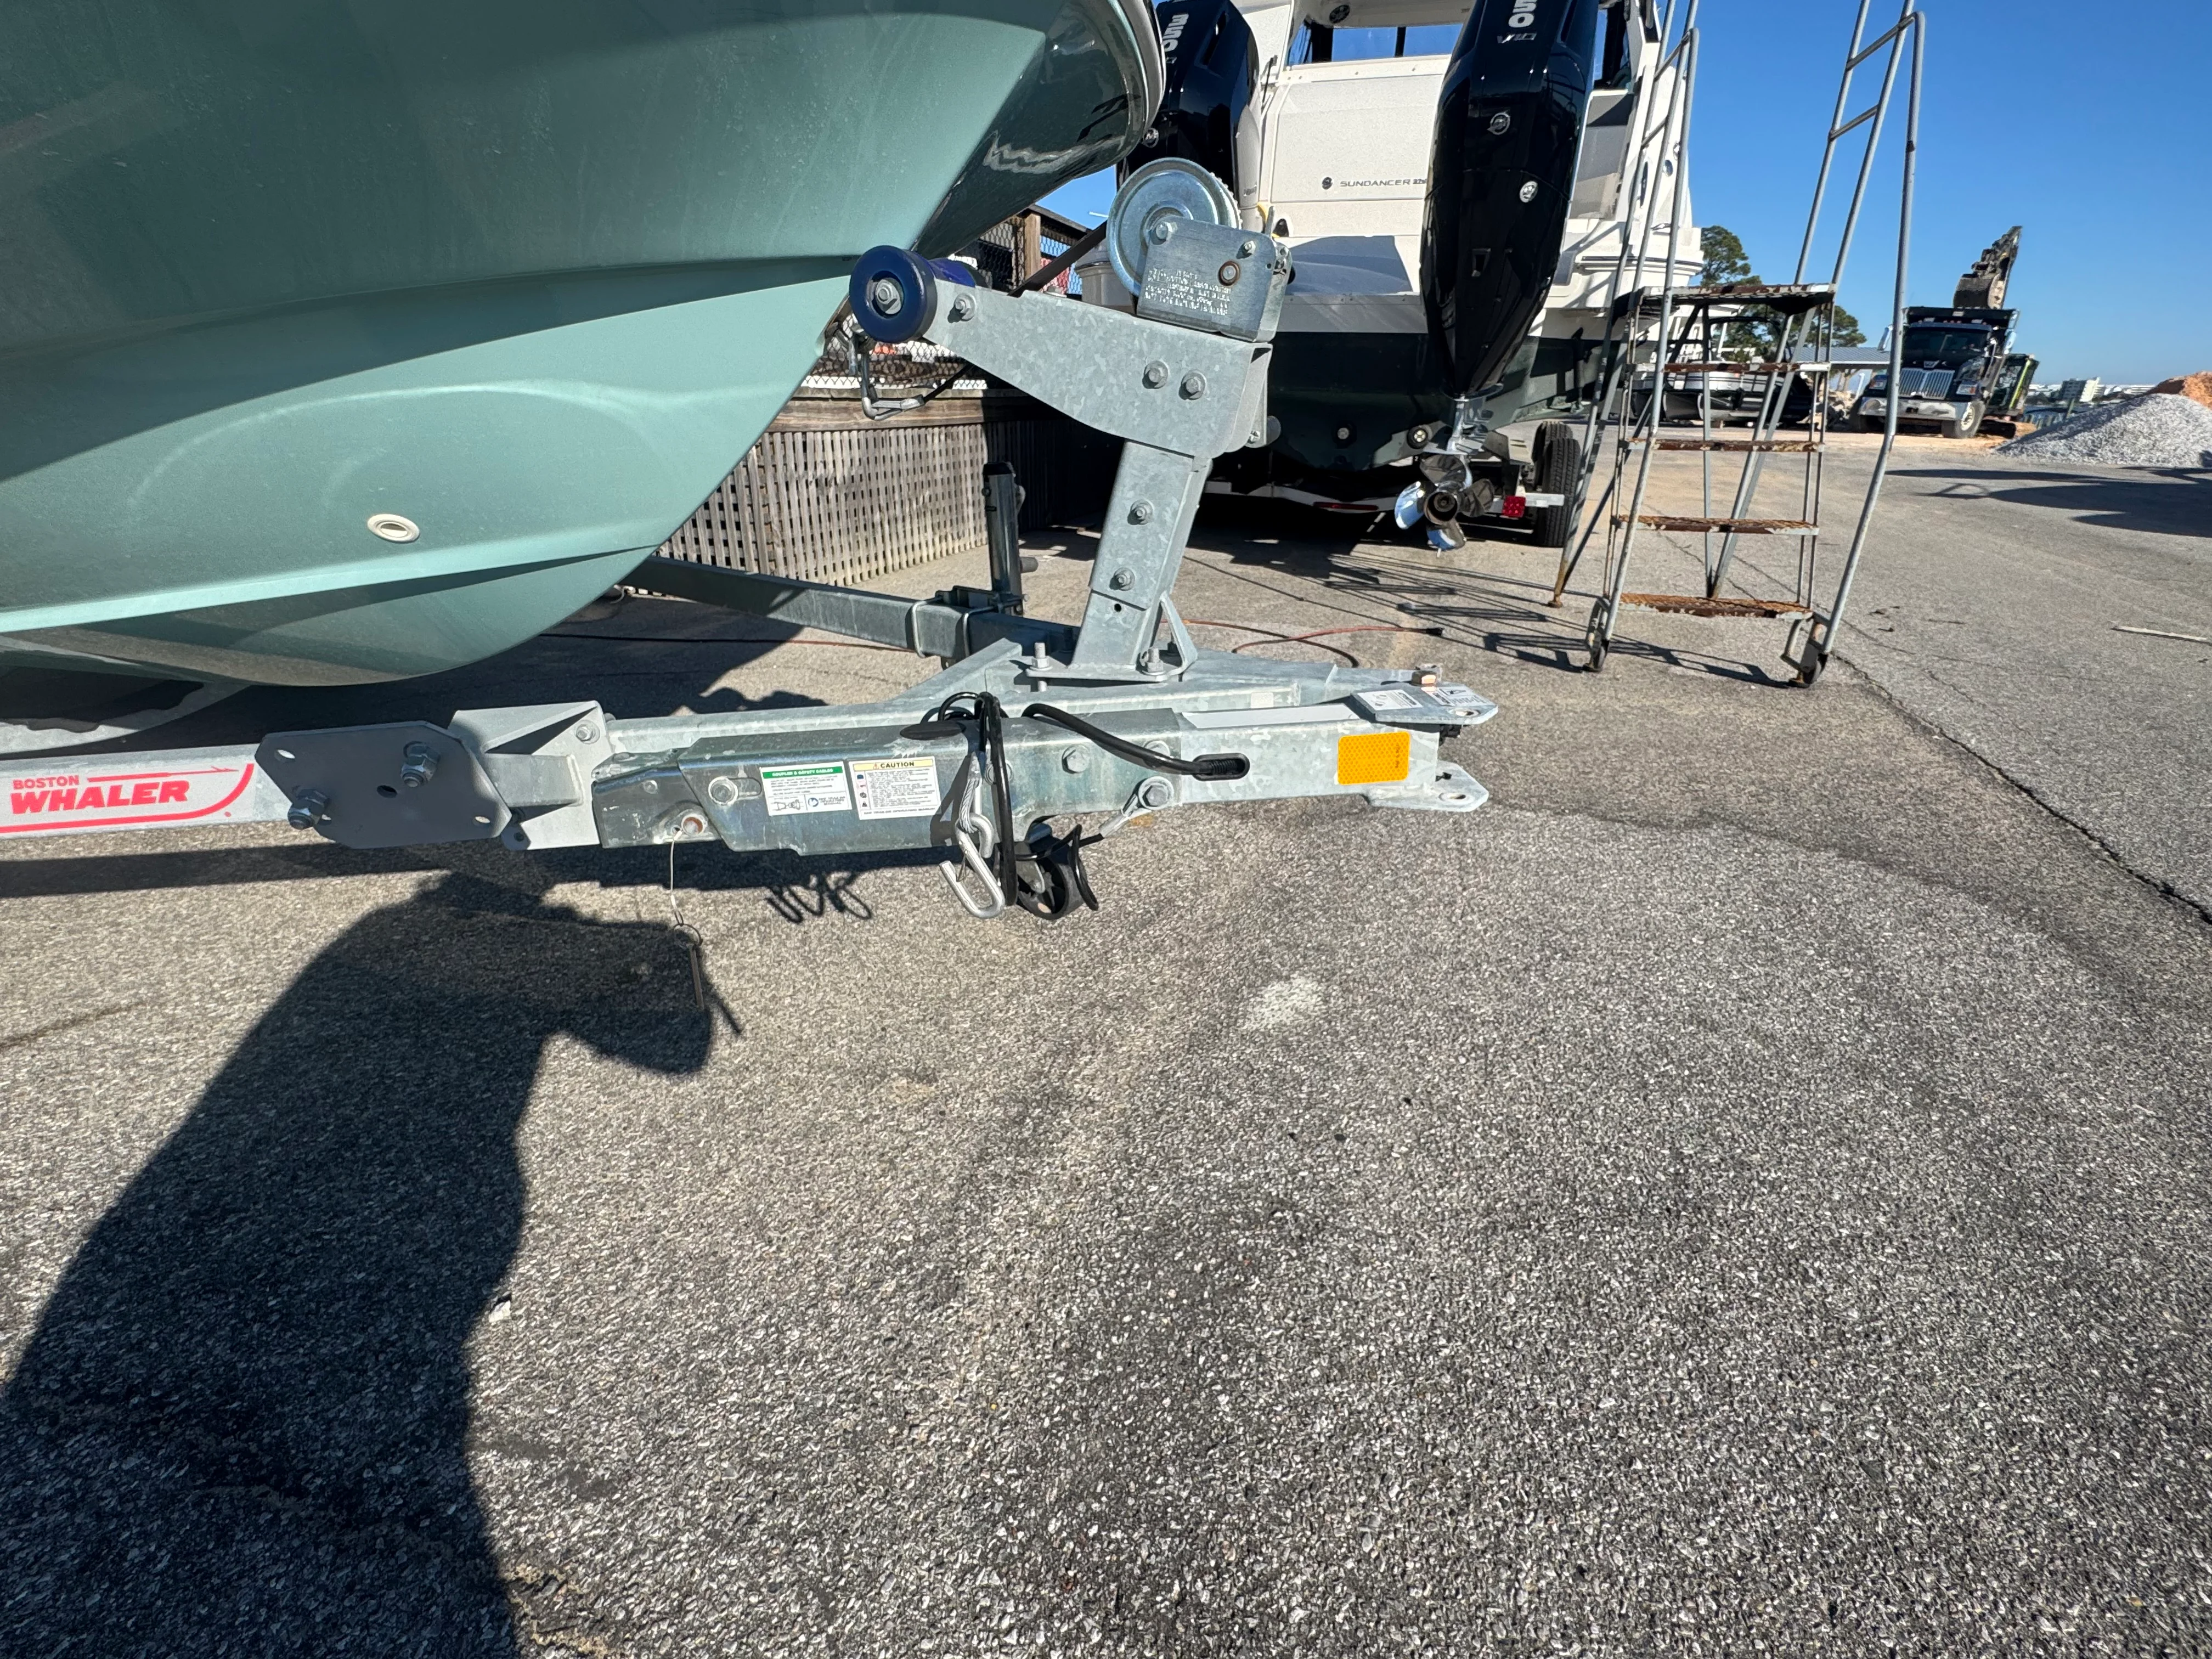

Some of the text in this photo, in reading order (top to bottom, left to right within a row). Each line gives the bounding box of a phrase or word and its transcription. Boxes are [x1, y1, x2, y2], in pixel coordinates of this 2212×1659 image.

[1162, 13, 1189, 52] 350
[1340, 179, 1410, 187] SUNDANCER
[13, 775, 79, 790] BOSTON
[10, 780, 190, 815] WHALER
